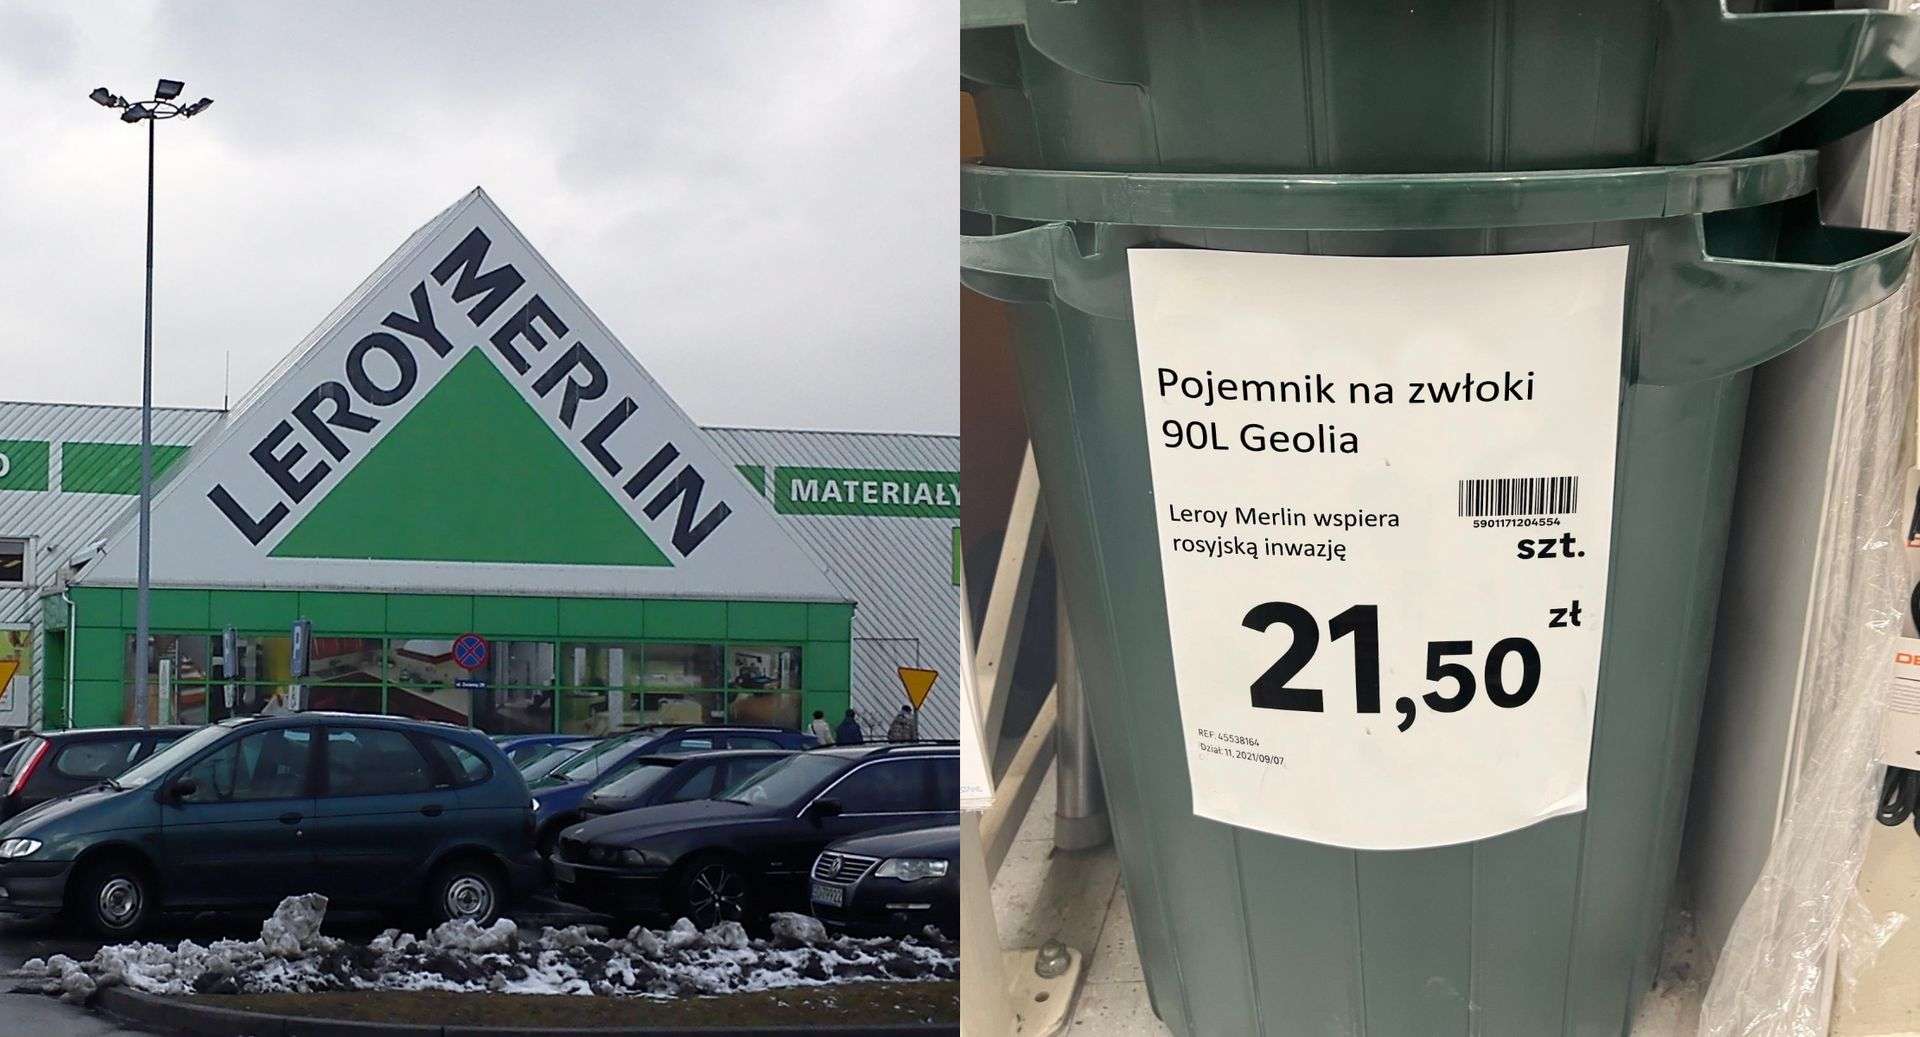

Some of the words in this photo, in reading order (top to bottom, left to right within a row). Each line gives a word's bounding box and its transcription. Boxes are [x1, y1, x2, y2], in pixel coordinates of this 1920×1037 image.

[207, 281, 454, 546] LEROY
[430, 226, 732, 558] MERLIN
[1156, 367, 1336, 407] Pojemnik
[1349, 381, 1393, 405] na
[1408, 371, 1535, 404] zwłoki
[1162, 419, 1230, 451] 90L
[1239, 422, 1359, 454] Geolia
[791, 479, 960, 506] MATERIAŁY
[1169, 503, 1228, 528] Leroy
[1235, 505, 1306, 527] Merlin
[1313, 508, 1400, 531] wspiera
[1472, 517, 1561, 529] 5901171204554
[1173, 535, 1259, 561] rosyjską
[1264, 537, 1346, 562] inwazję
[1516, 532, 1586, 560] szt.
[1241, 601, 1542, 733] 21,50
[1548, 600, 1582, 628] zł
